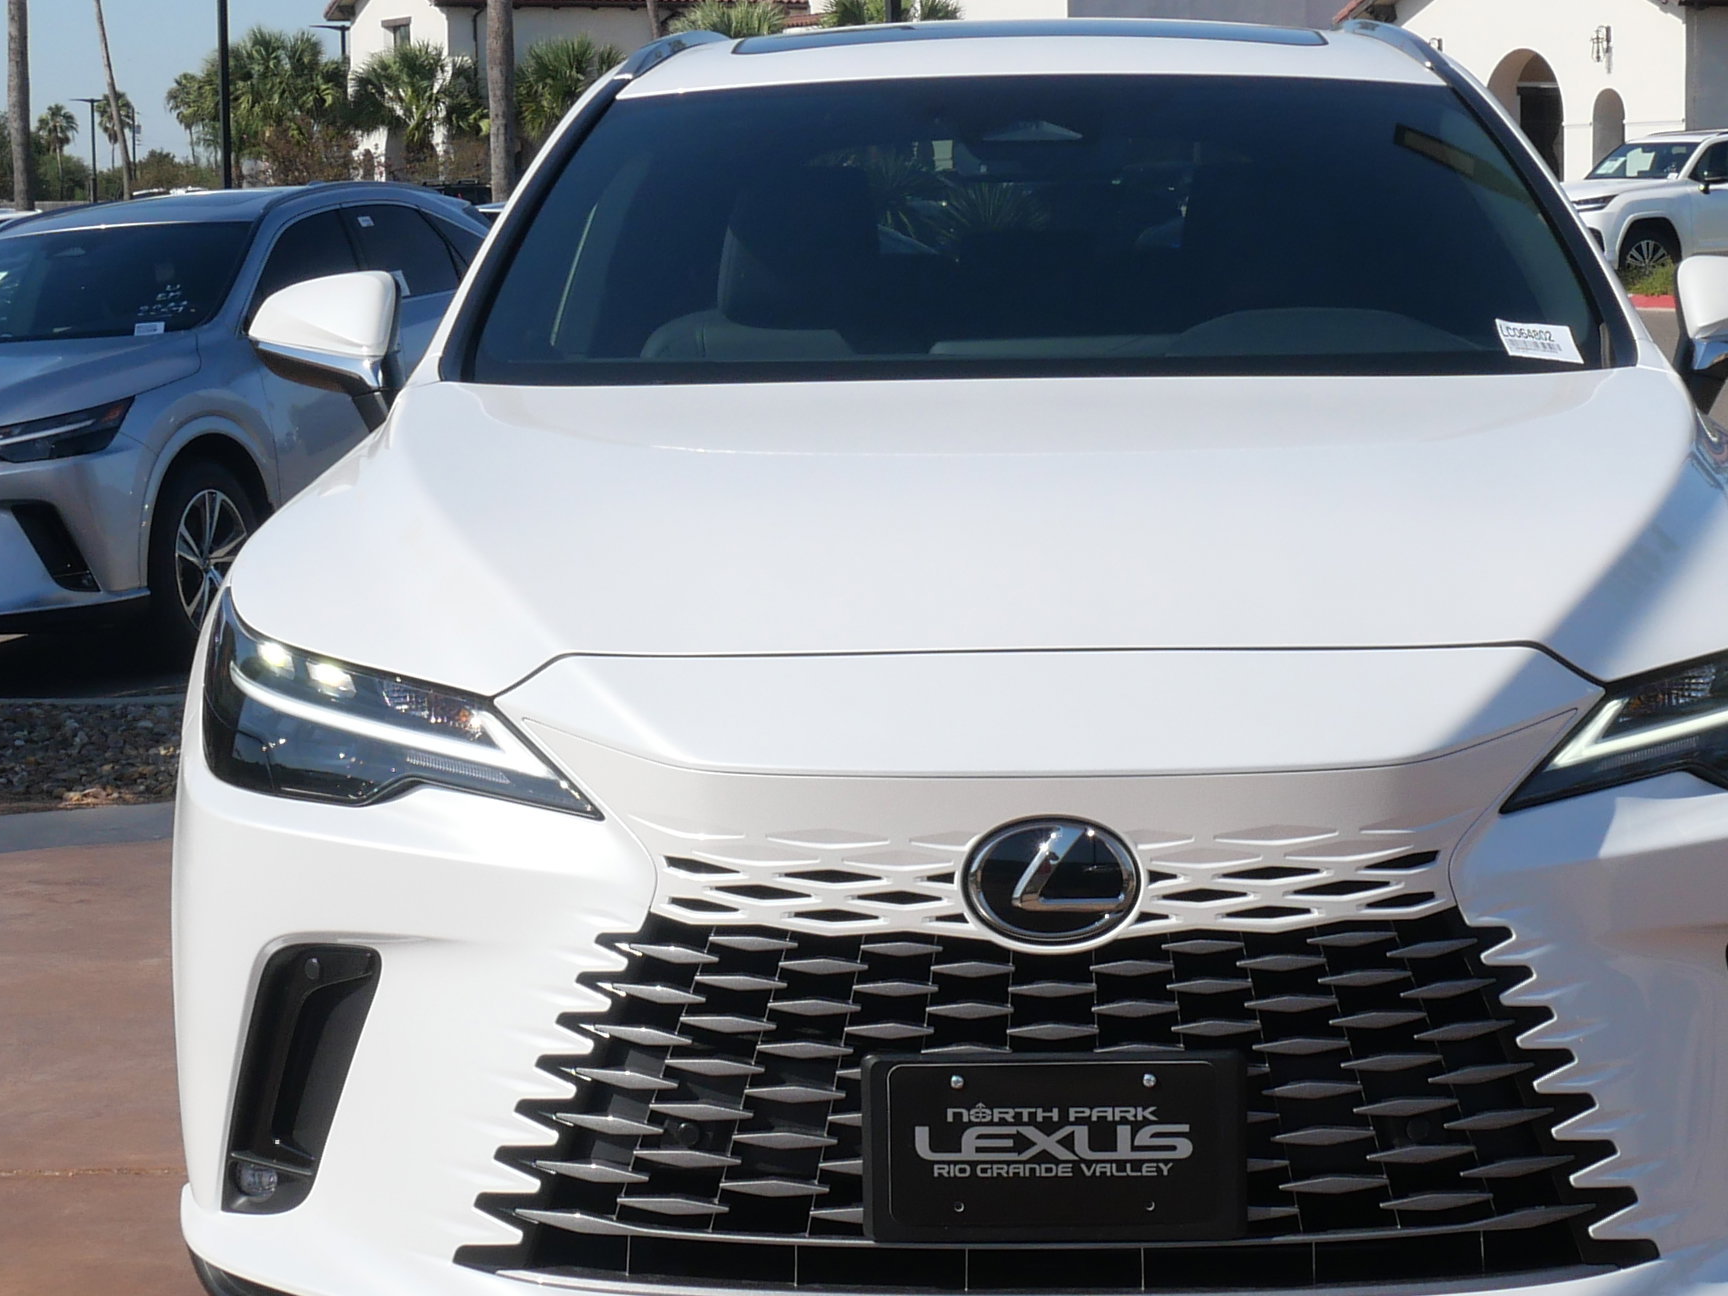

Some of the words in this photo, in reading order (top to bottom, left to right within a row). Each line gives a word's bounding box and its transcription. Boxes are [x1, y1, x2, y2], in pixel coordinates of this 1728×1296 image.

[946, 1105, 1059, 1123] NORTH
[1068, 1105, 1159, 1122] PARK
[914, 1124, 1194, 1161] LEXUS
[932, 1163, 971, 1178] RIO
[975, 1163, 1073, 1177] GRANDE
[1080, 1161, 1174, 1177] VALLEY
